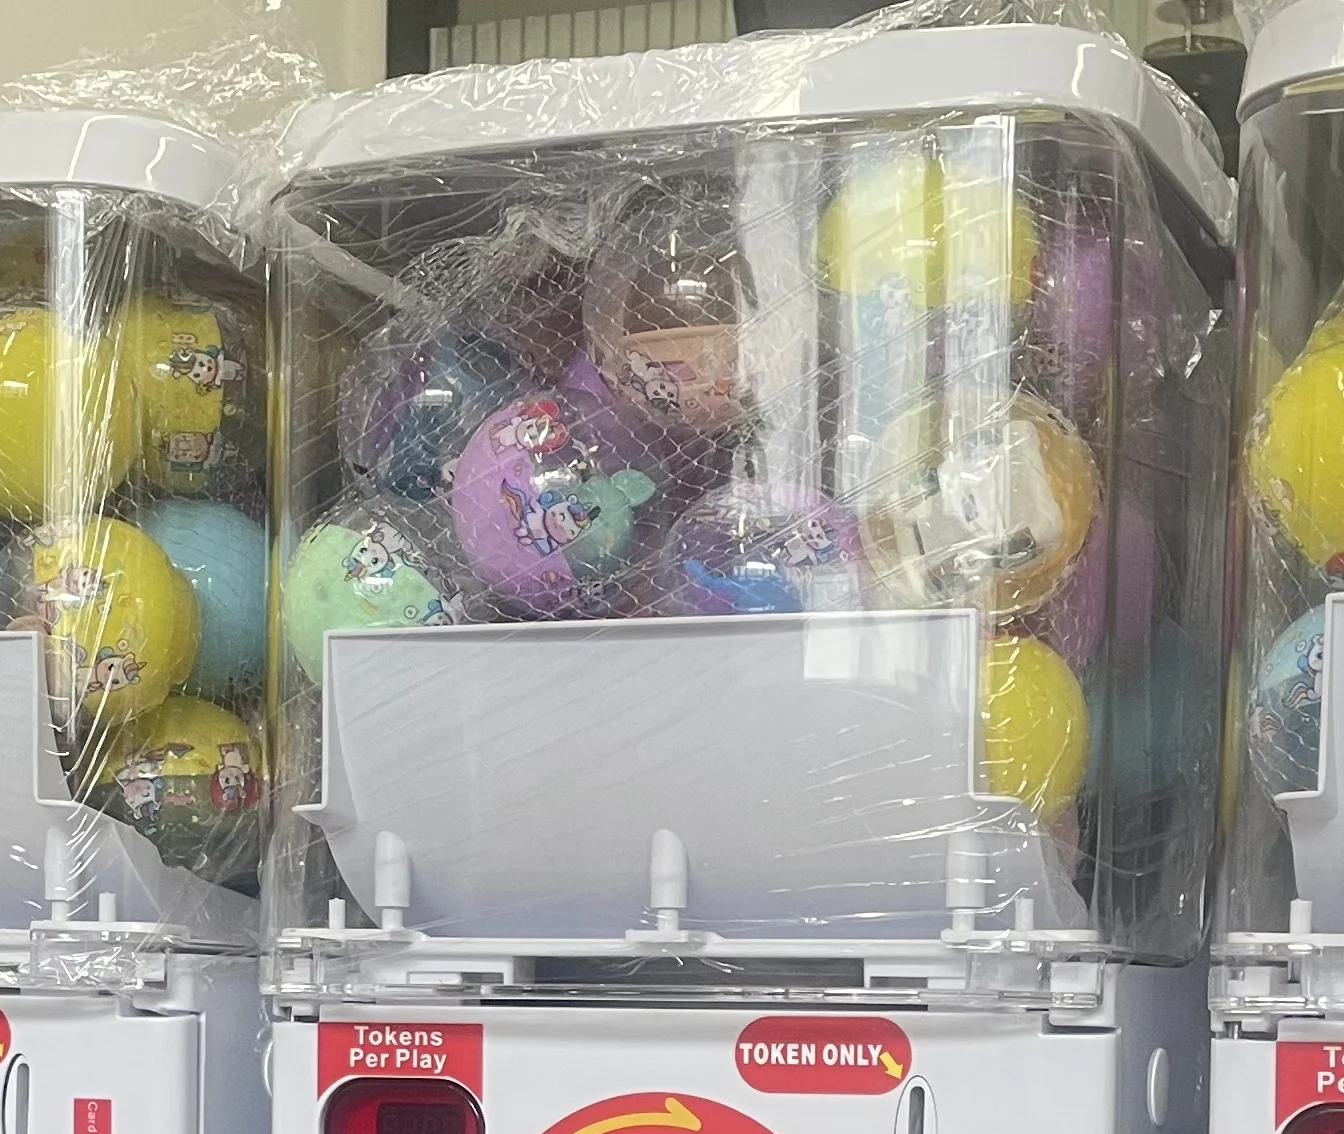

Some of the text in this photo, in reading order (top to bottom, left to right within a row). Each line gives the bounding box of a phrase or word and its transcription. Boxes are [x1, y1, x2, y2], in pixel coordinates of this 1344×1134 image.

[354, 1025, 443, 1047] Tokens
[349, 1047, 447, 1074] Per Play
[739, 1042, 881, 1067] TOKEN ONLY
[87, 1101, 98, 1133] Card
